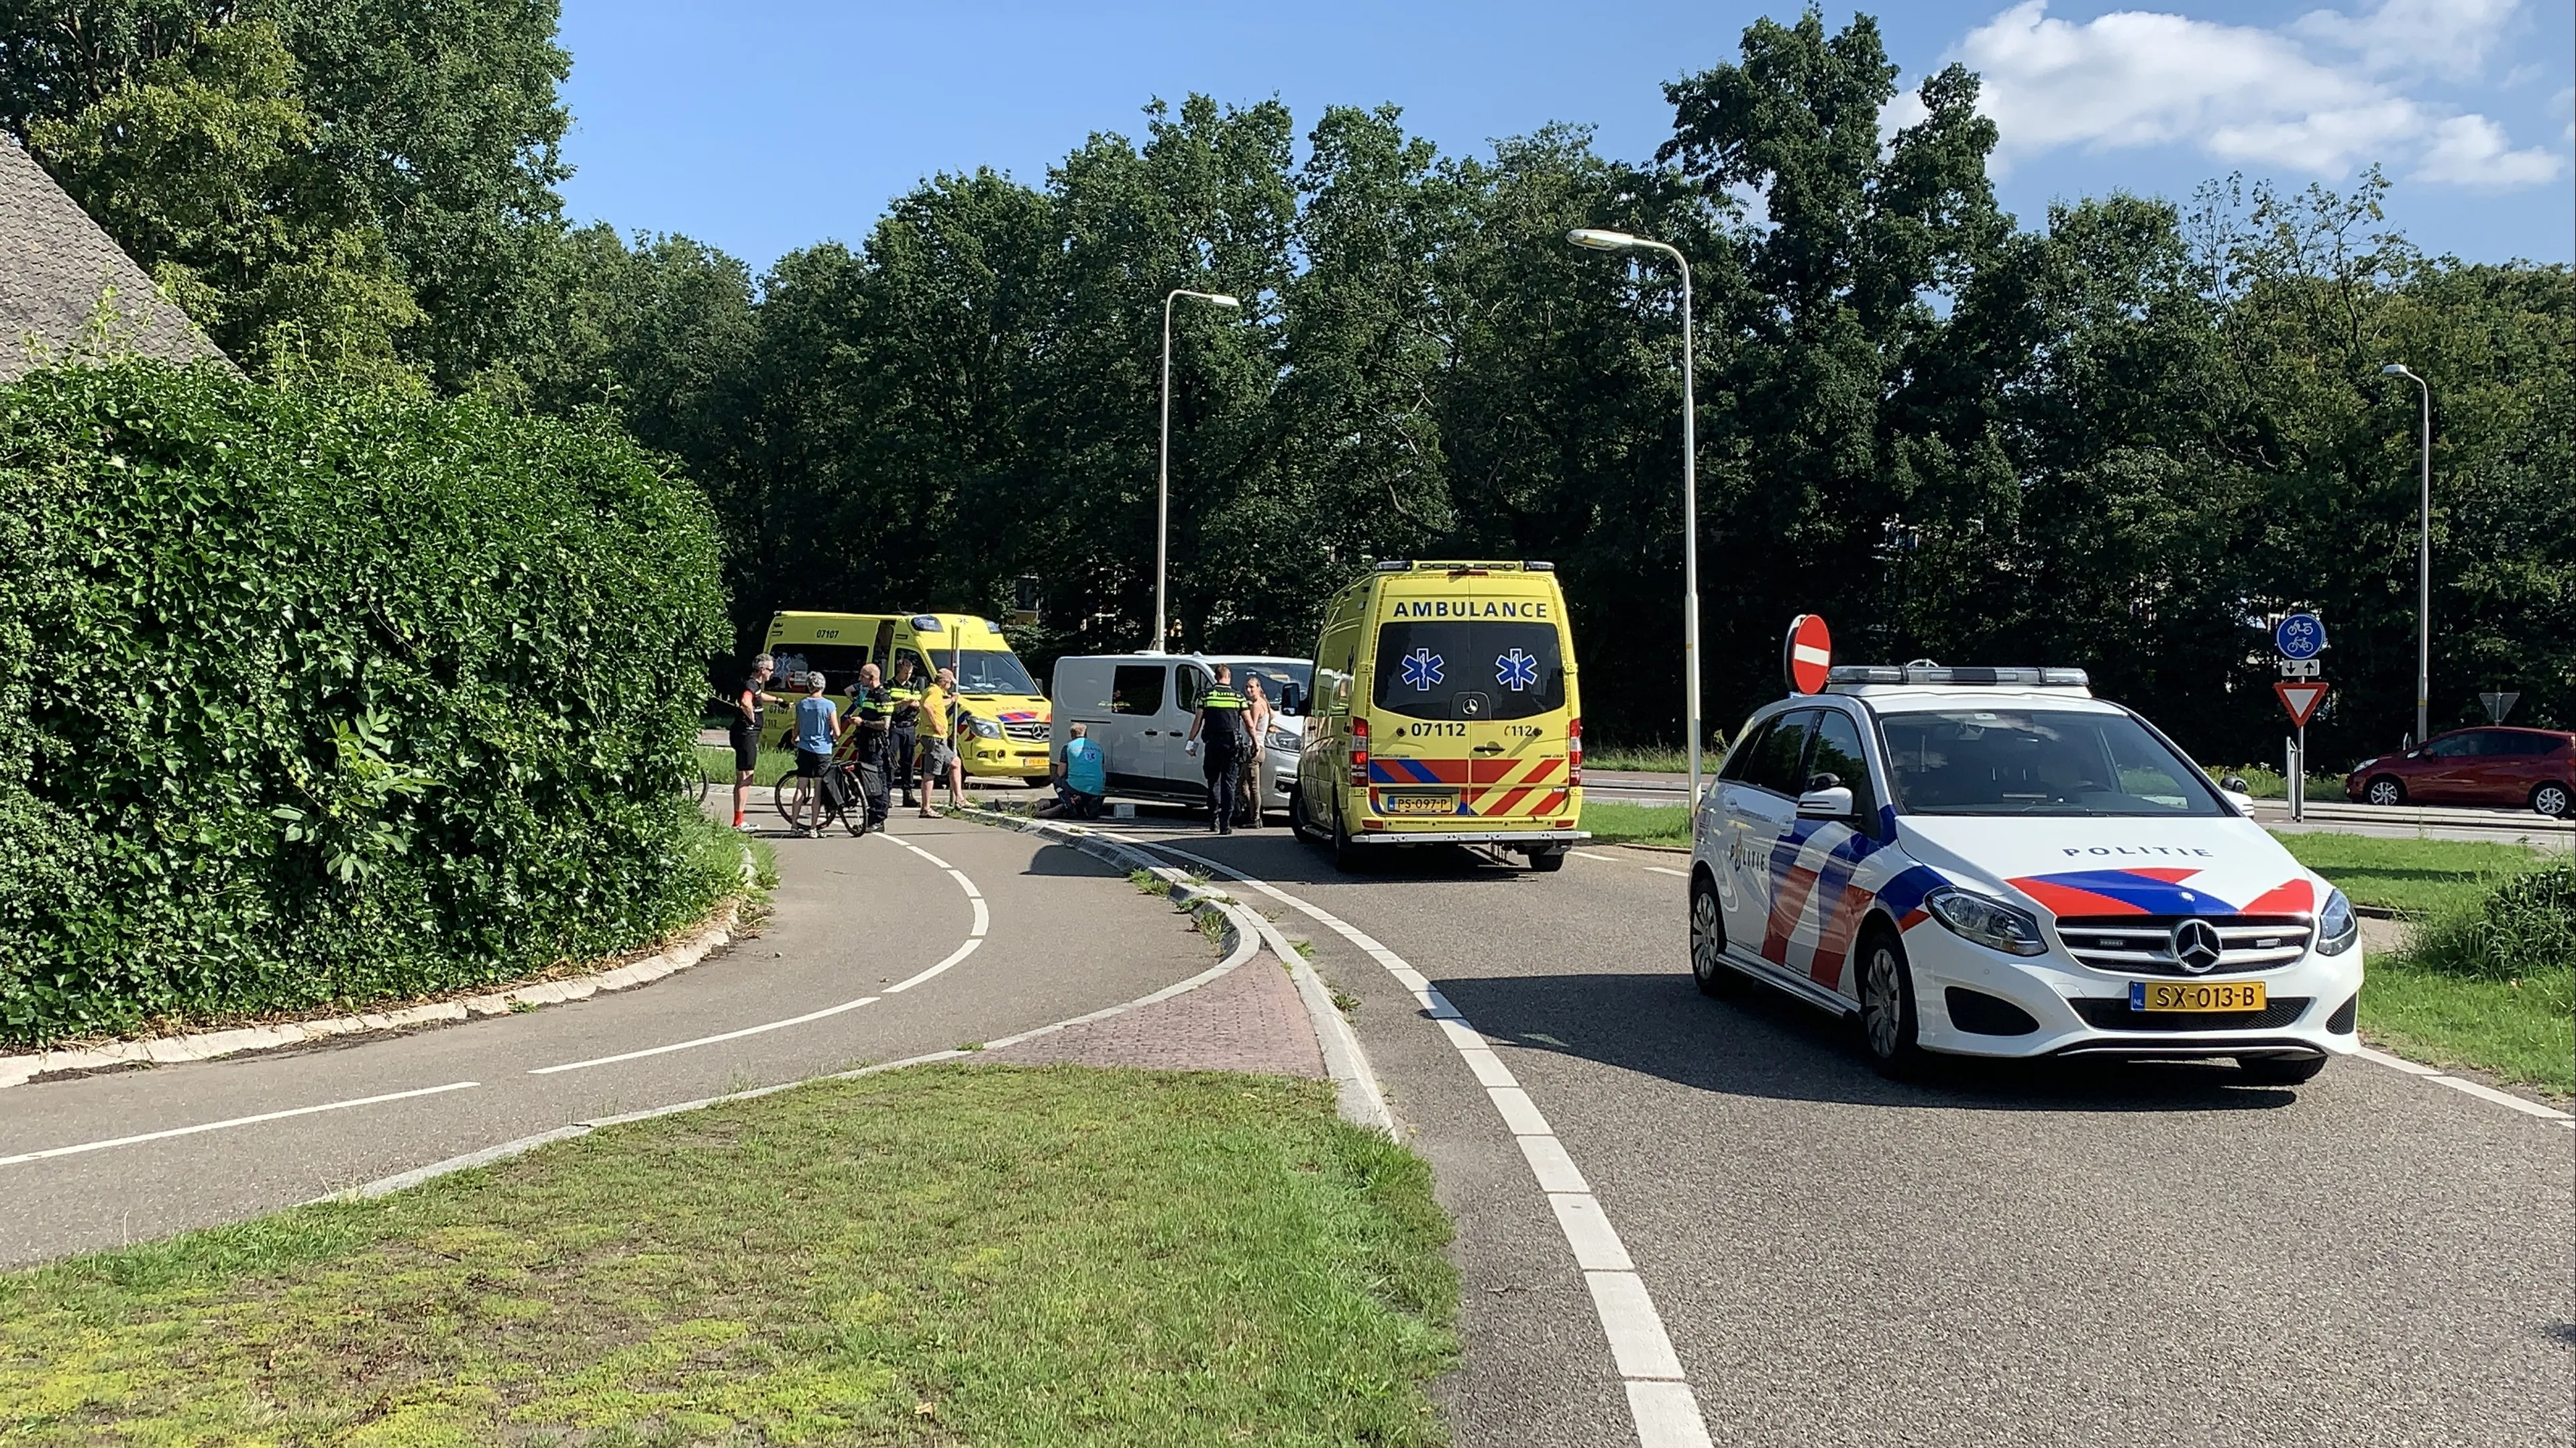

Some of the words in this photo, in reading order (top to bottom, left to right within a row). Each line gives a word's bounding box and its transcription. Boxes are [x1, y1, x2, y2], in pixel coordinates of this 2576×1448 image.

[1393, 602, 1547, 618] AMBULANCE
[816, 629, 839, 638] 07107
[1411, 723, 1466, 736] 07112
[1511, 725, 1533, 736] 112
[1397, 799, 1448, 809] PS-097-P
[2062, 846, 2214, 857] POLITIE
[1730, 844, 1765, 872] POLITIE
[2133, 998, 2143, 1006] NL
[2156, 986, 2255, 1007] SX-013-B
